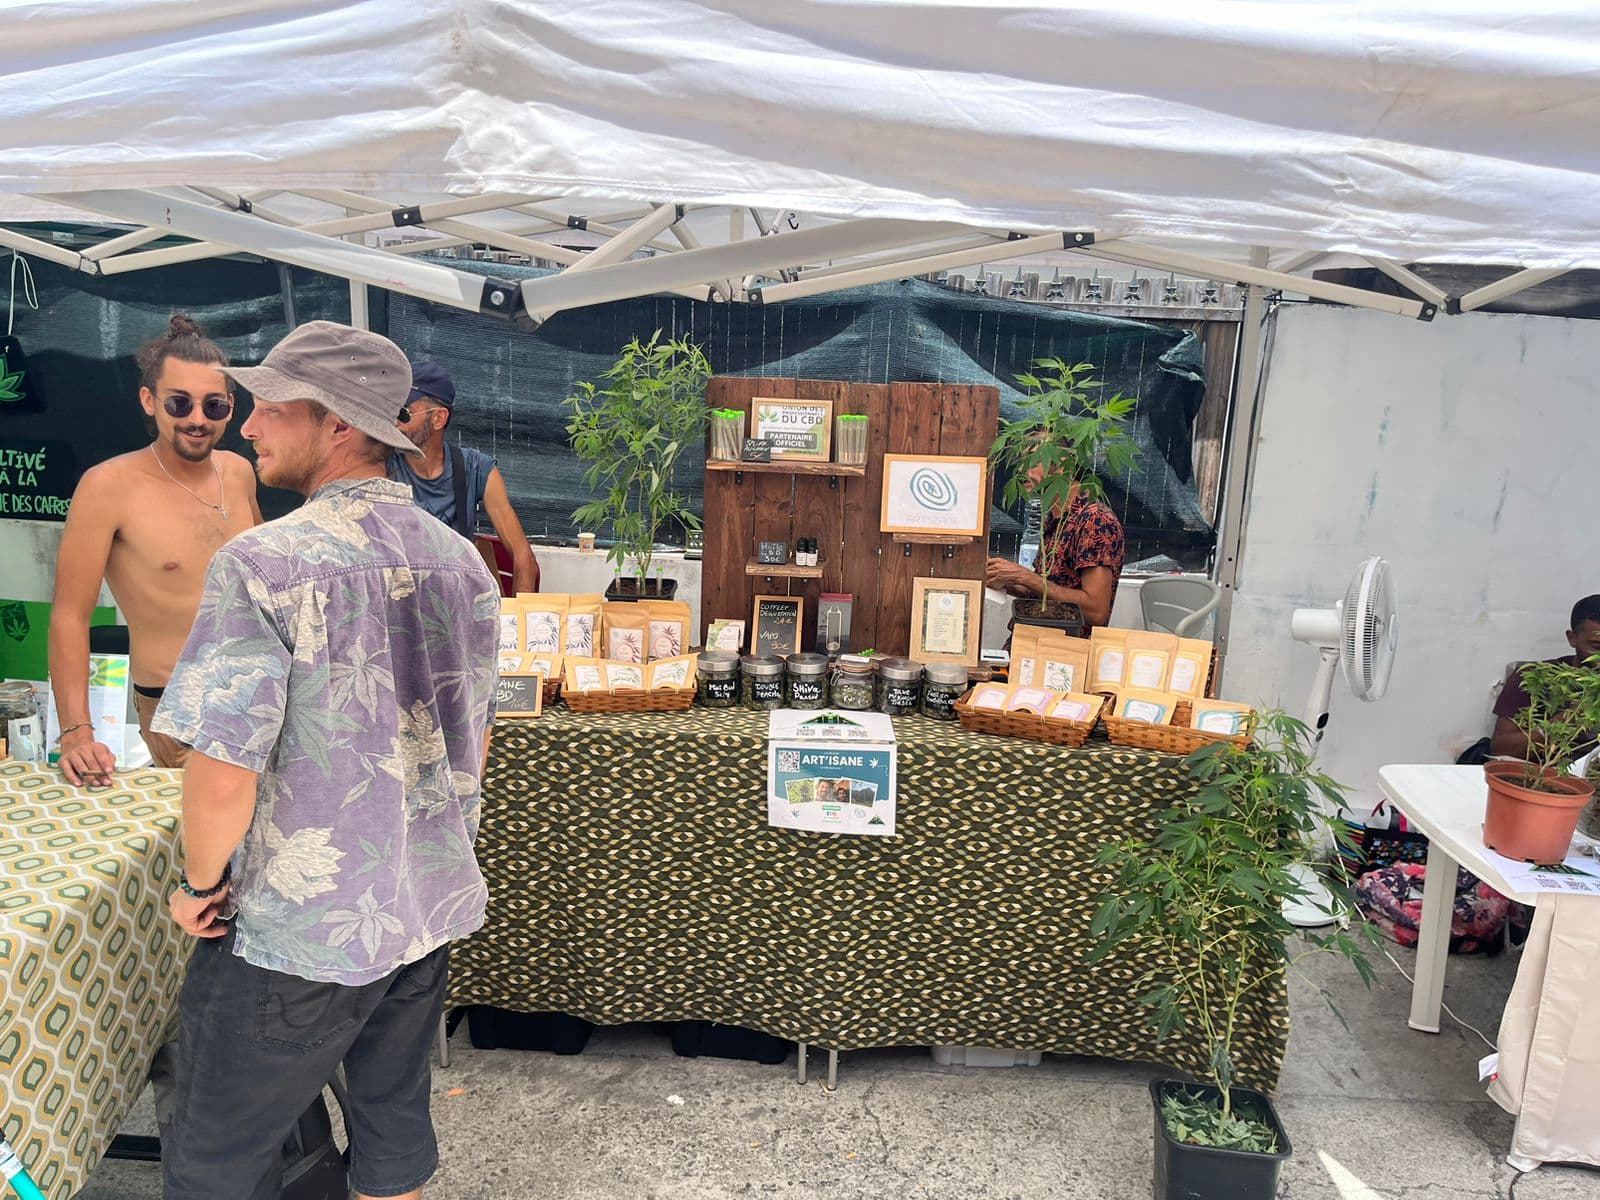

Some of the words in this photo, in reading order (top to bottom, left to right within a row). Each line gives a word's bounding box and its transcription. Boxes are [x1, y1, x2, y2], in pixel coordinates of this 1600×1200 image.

[782, 415, 798, 424] DU
[801, 416, 823, 425] CBD
[769, 433, 813, 441] PARTENAIRE
[18, 470, 38, 488] LA
[12, 494, 33, 513] DES
[498, 680, 526, 690] ANE
[496, 690, 513, 702] BD
[802, 754, 864, 767] ART'ISANE
